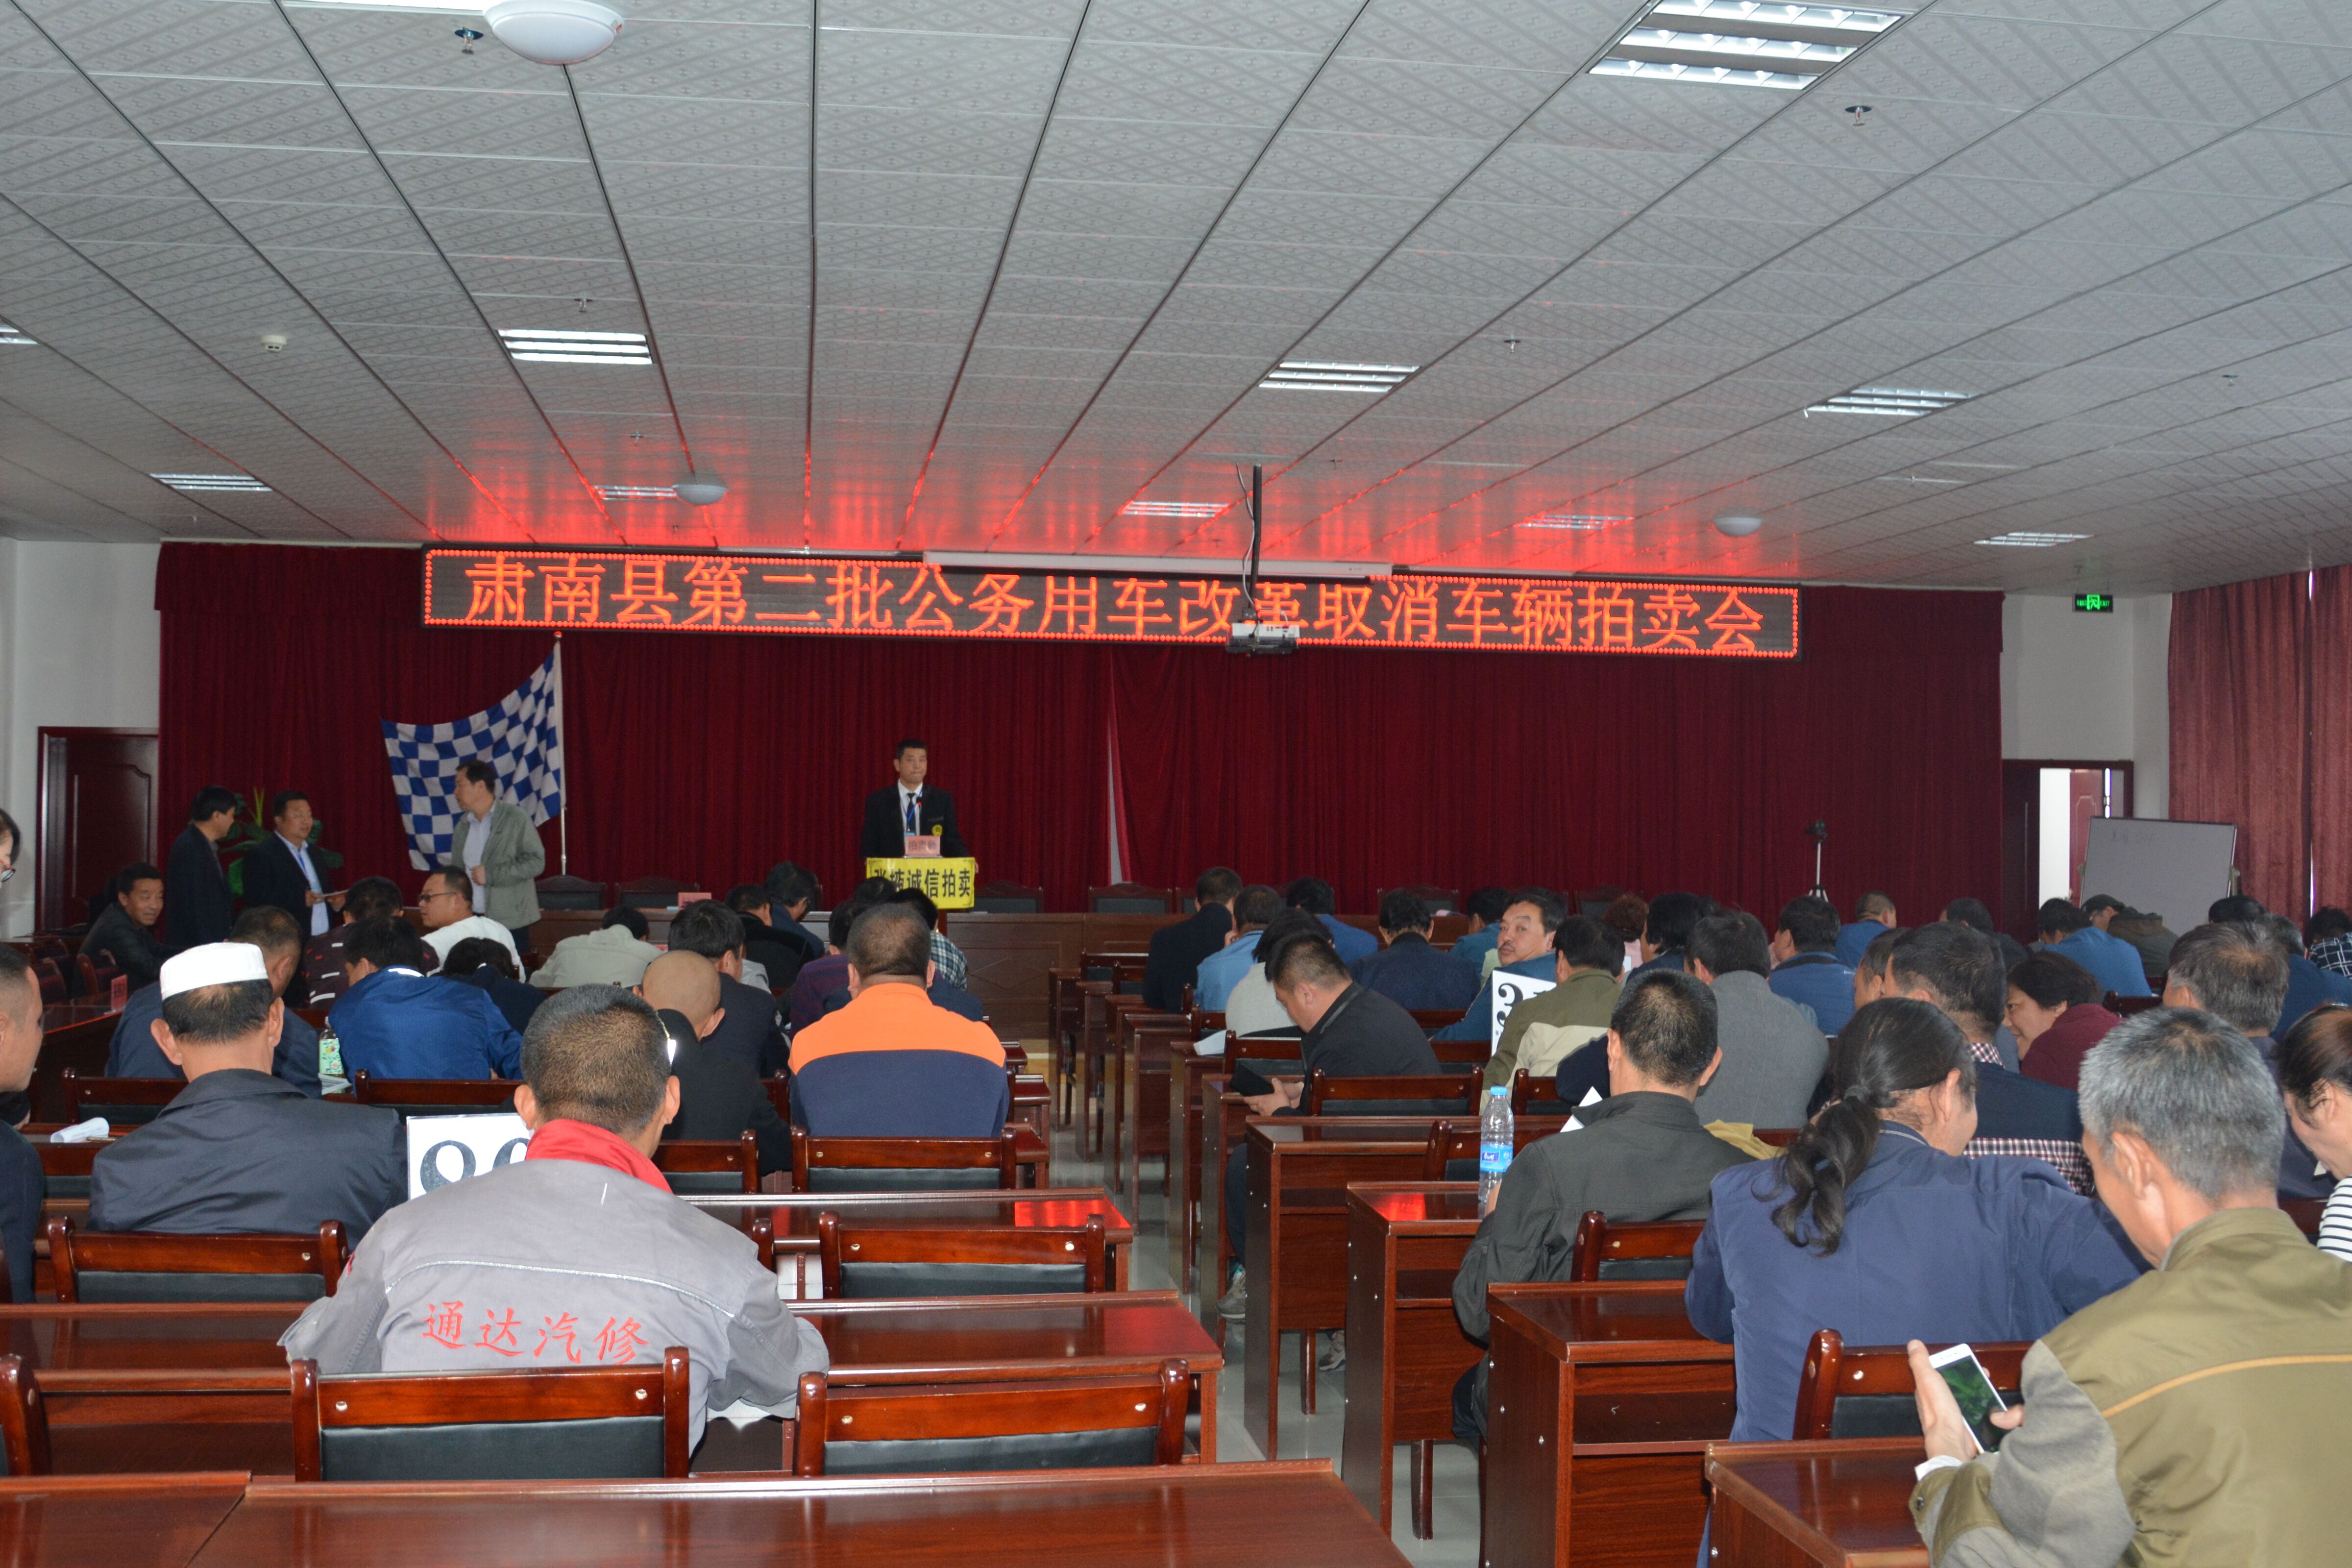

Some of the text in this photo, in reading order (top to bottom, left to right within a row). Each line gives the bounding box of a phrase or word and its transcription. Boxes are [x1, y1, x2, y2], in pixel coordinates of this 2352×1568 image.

[465, 554, 1764, 653] 肃南县第二批公务用车改革取消车辆拍卖会
[1497, 982, 1547, 1027] 3
[421, 1300, 649, 1366] 通达汽修
